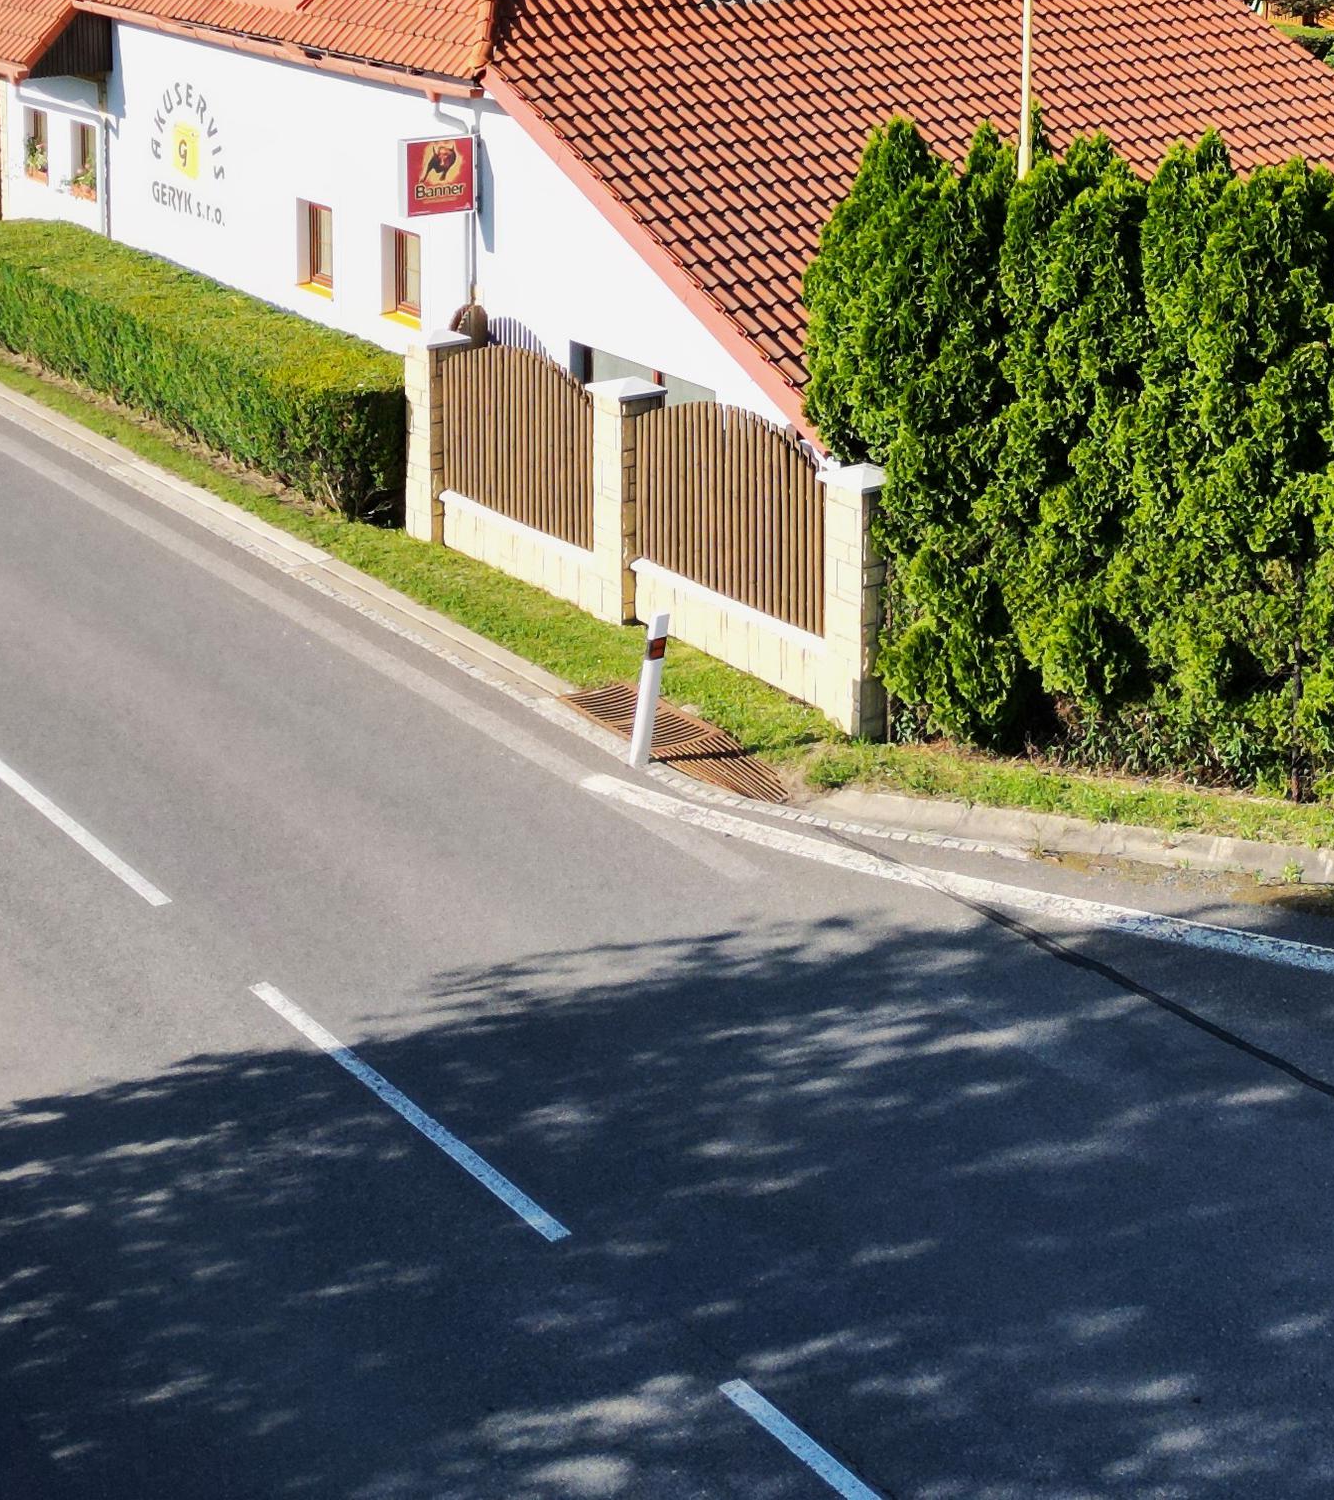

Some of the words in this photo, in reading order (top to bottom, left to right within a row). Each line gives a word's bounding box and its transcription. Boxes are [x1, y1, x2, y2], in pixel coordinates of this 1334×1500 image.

[151, 82, 226, 181] AKUSERVIS
[152, 180, 193, 215] GERYK
[196, 201, 226, 227] s.r.o.
[415, 184, 466, 200] Banner
